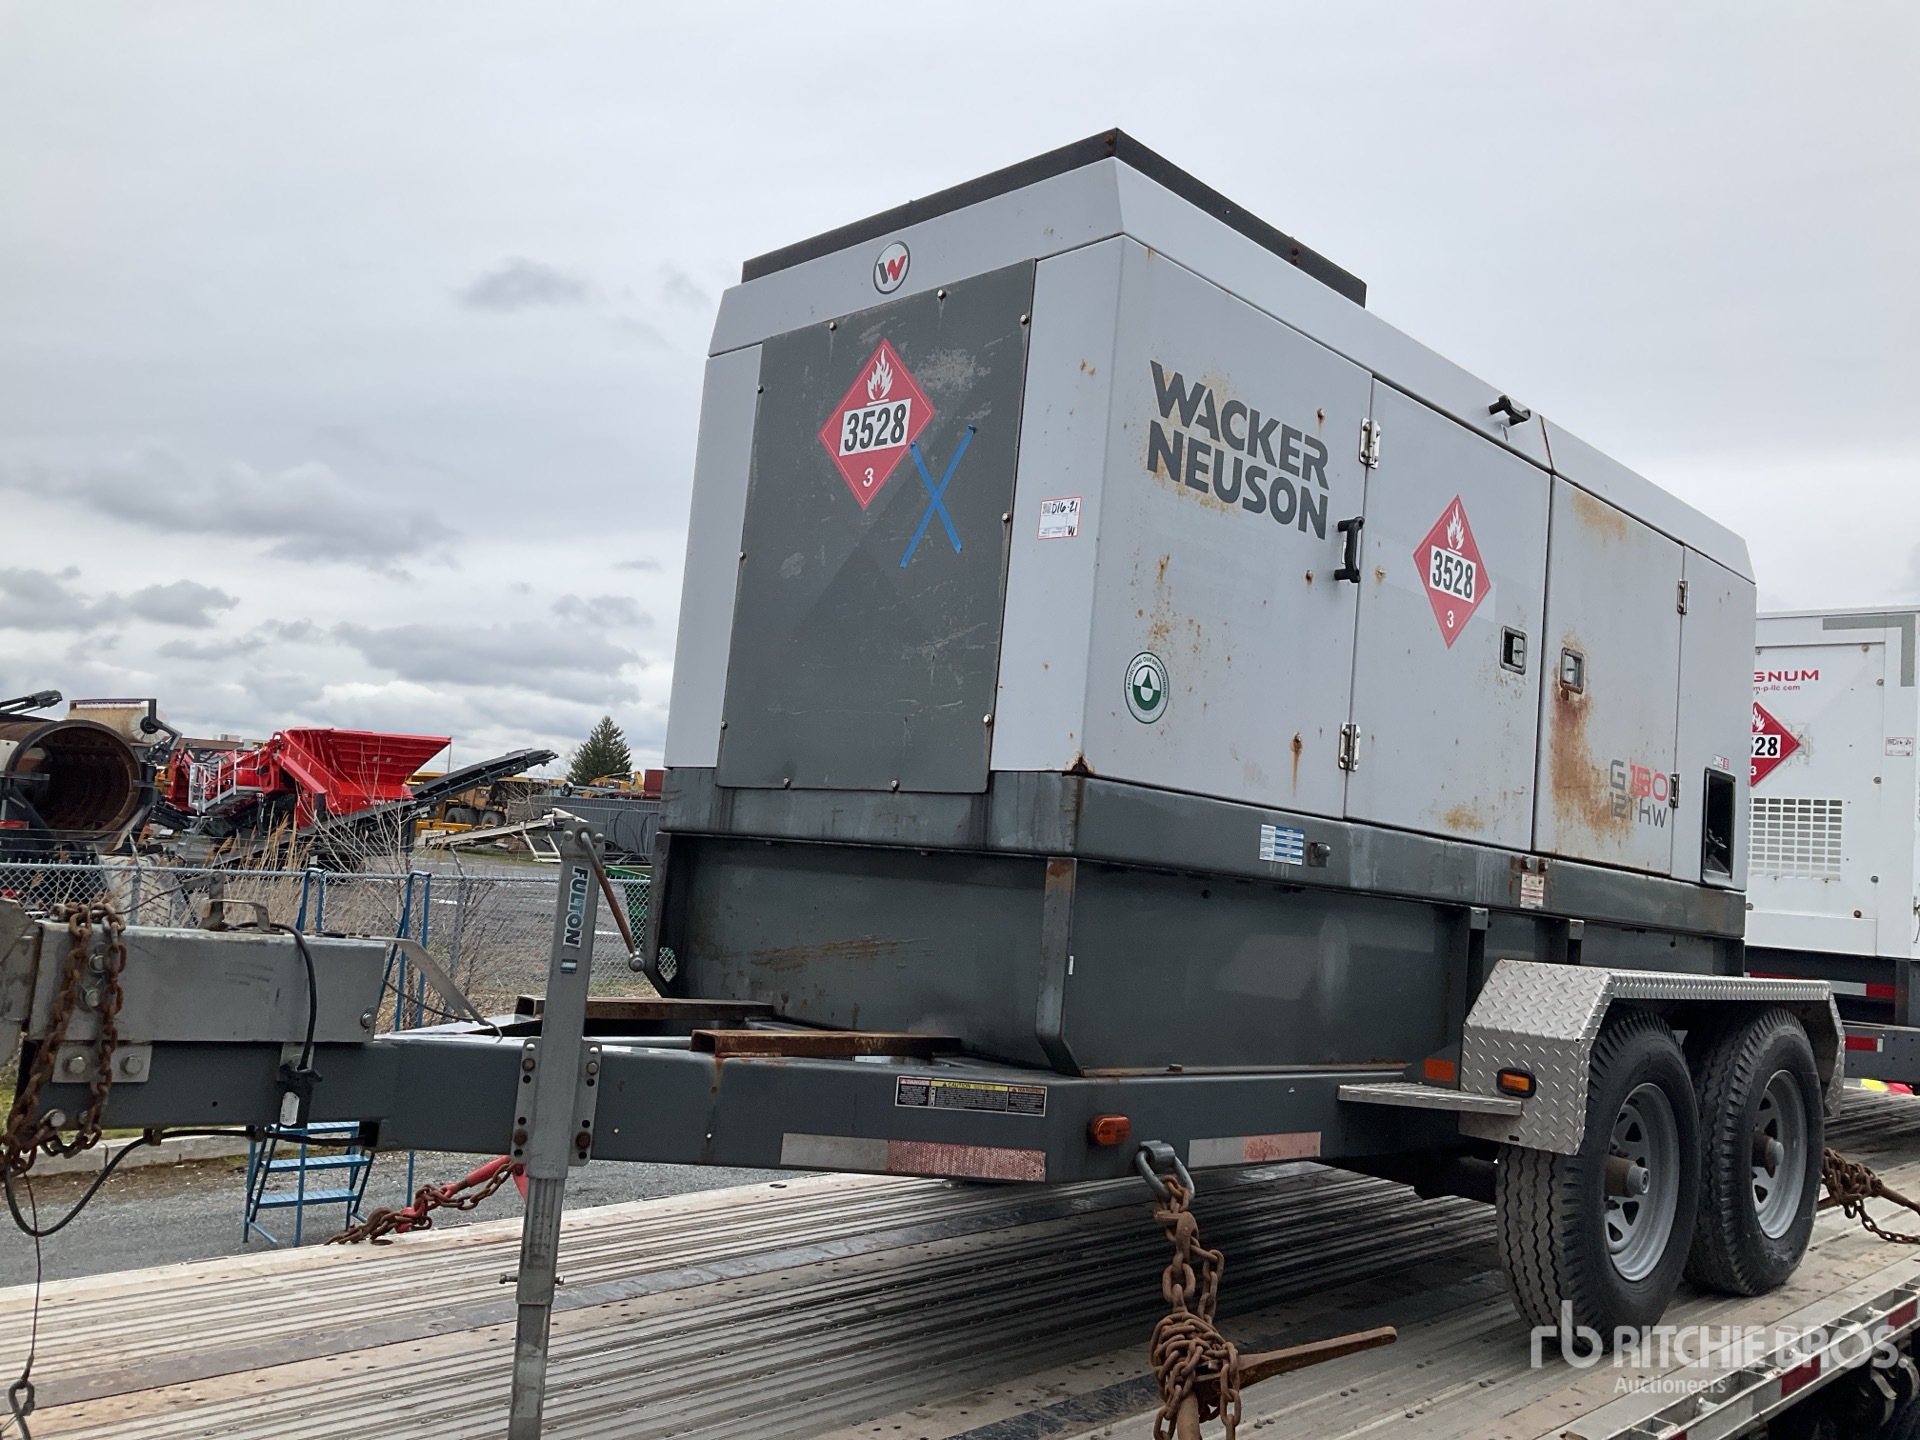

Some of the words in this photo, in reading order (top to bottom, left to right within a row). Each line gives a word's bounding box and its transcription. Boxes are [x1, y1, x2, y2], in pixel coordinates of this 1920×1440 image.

[844, 403, 907, 452] 3528
[1150, 359, 1329, 490] WACKER
[863, 467, 874, 487] 3
[1147, 419, 1329, 540] NEUSON
[1432, 550, 1473, 599] 3528
[1446, 610, 1454, 628] 3
[1751, 736, 1778, 756] 28
[563, 865, 590, 949] FULTON
